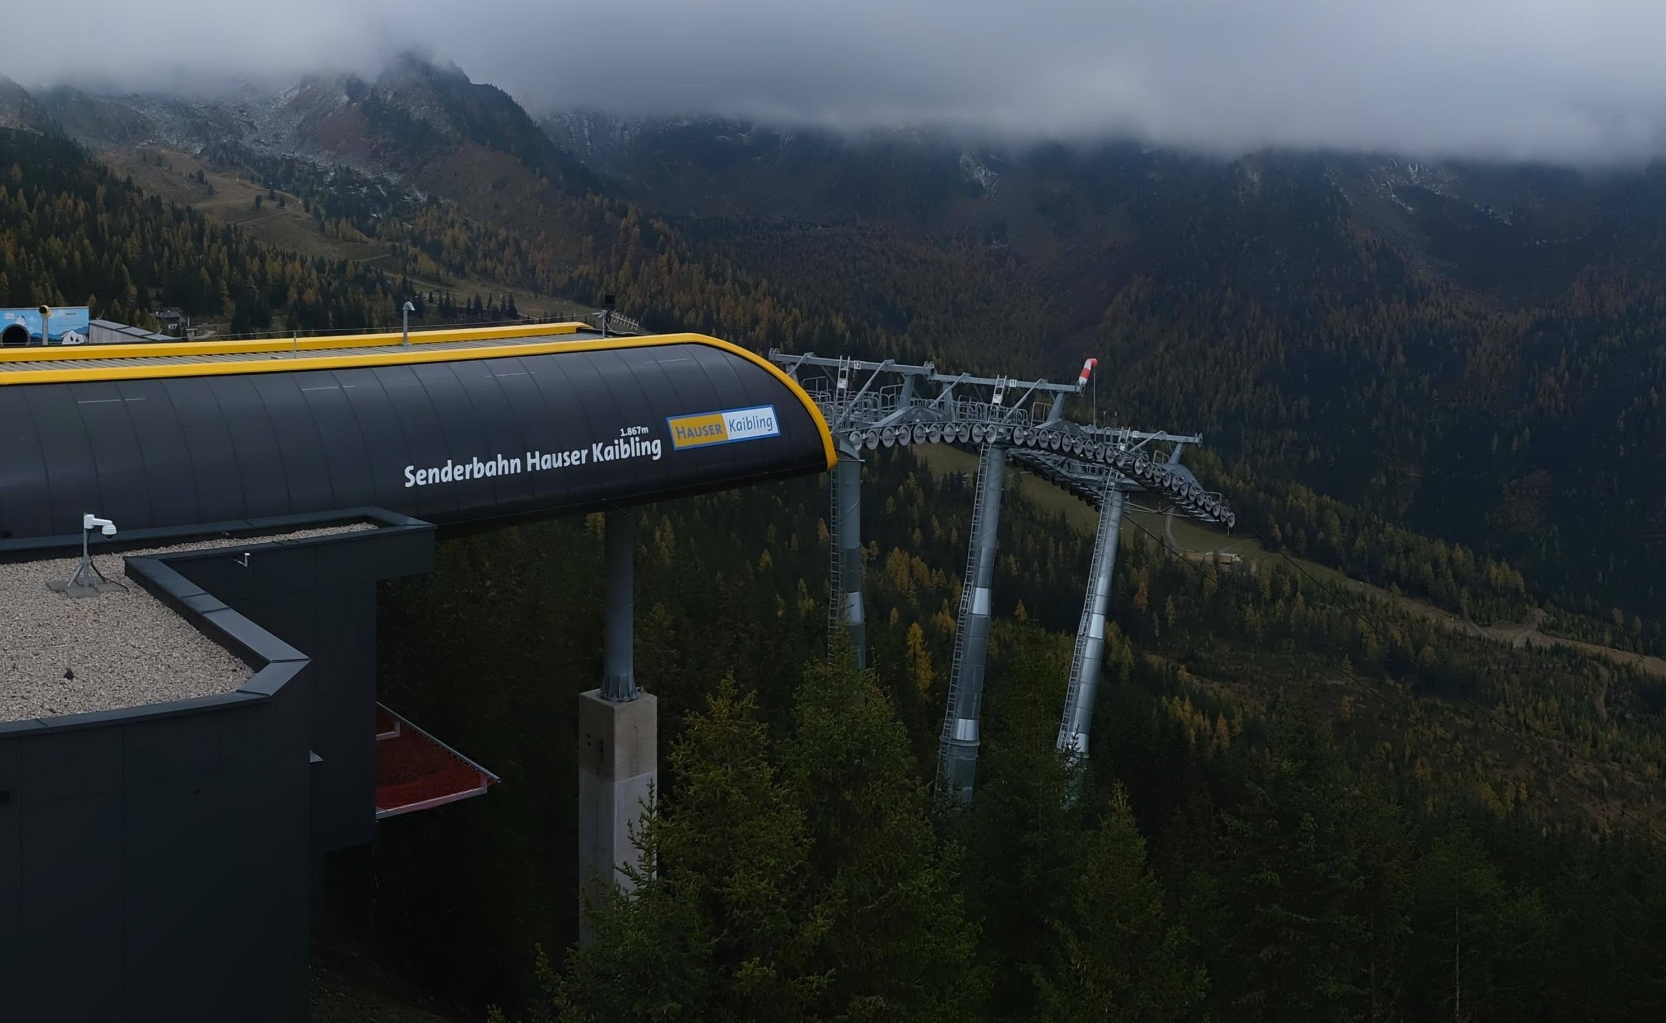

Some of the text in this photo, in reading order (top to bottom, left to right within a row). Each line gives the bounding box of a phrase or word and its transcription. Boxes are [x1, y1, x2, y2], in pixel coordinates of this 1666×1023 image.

[676, 413, 773, 440] HAUSER Kaibling
[404, 437, 662, 488] Senderbahn Hauser Kaibling
